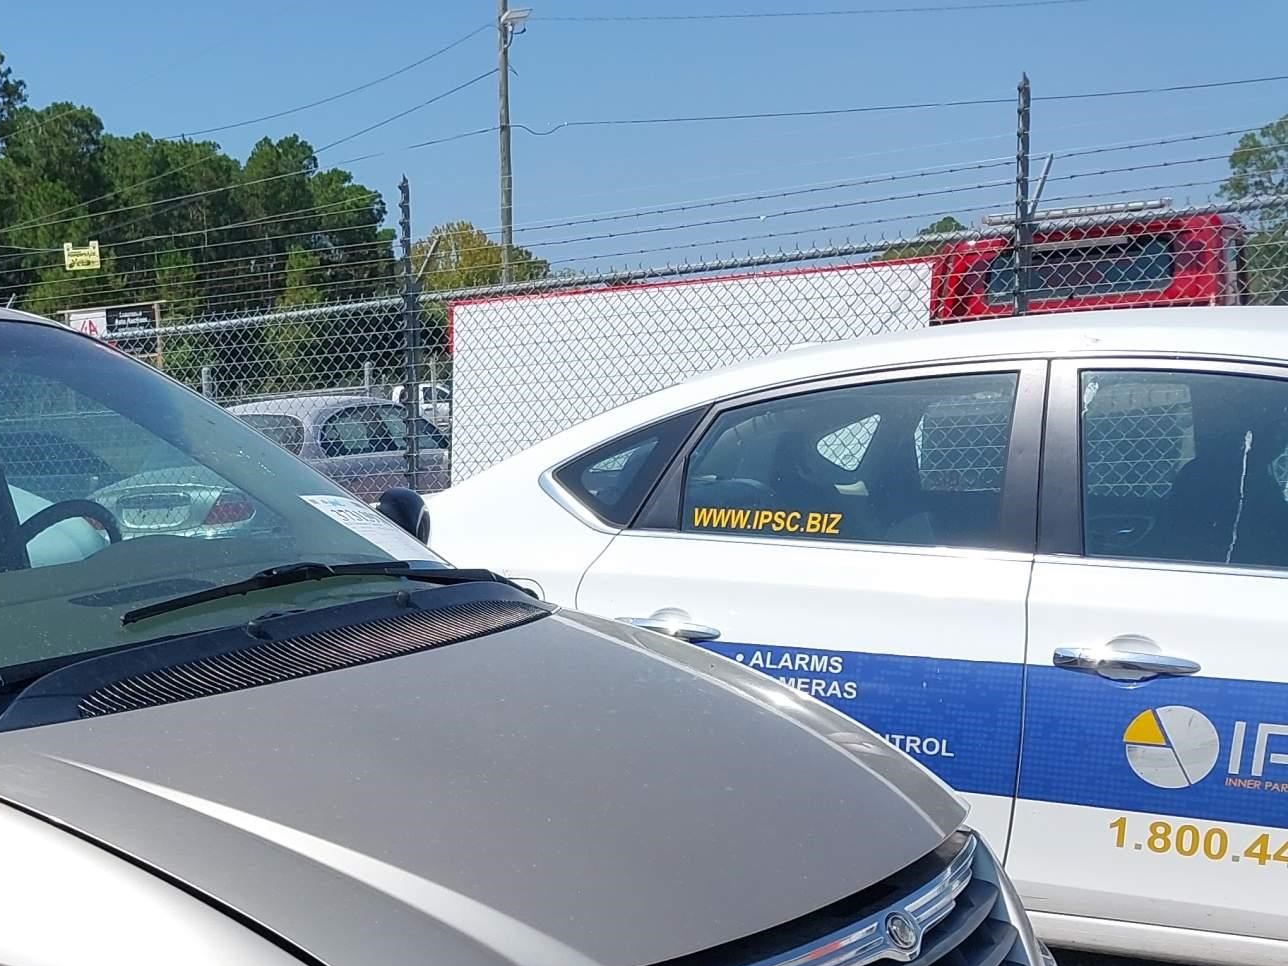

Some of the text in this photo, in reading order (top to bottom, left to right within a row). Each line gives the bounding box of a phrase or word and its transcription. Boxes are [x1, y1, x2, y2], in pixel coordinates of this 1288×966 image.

[693, 507, 842, 534] WWW.IPSC.BIZ
[749, 651, 843, 674] ALARMS
[779, 675, 857, 699] MERAS
[884, 733, 955, 757] TROL
[1224, 777, 1262, 790] INNER
